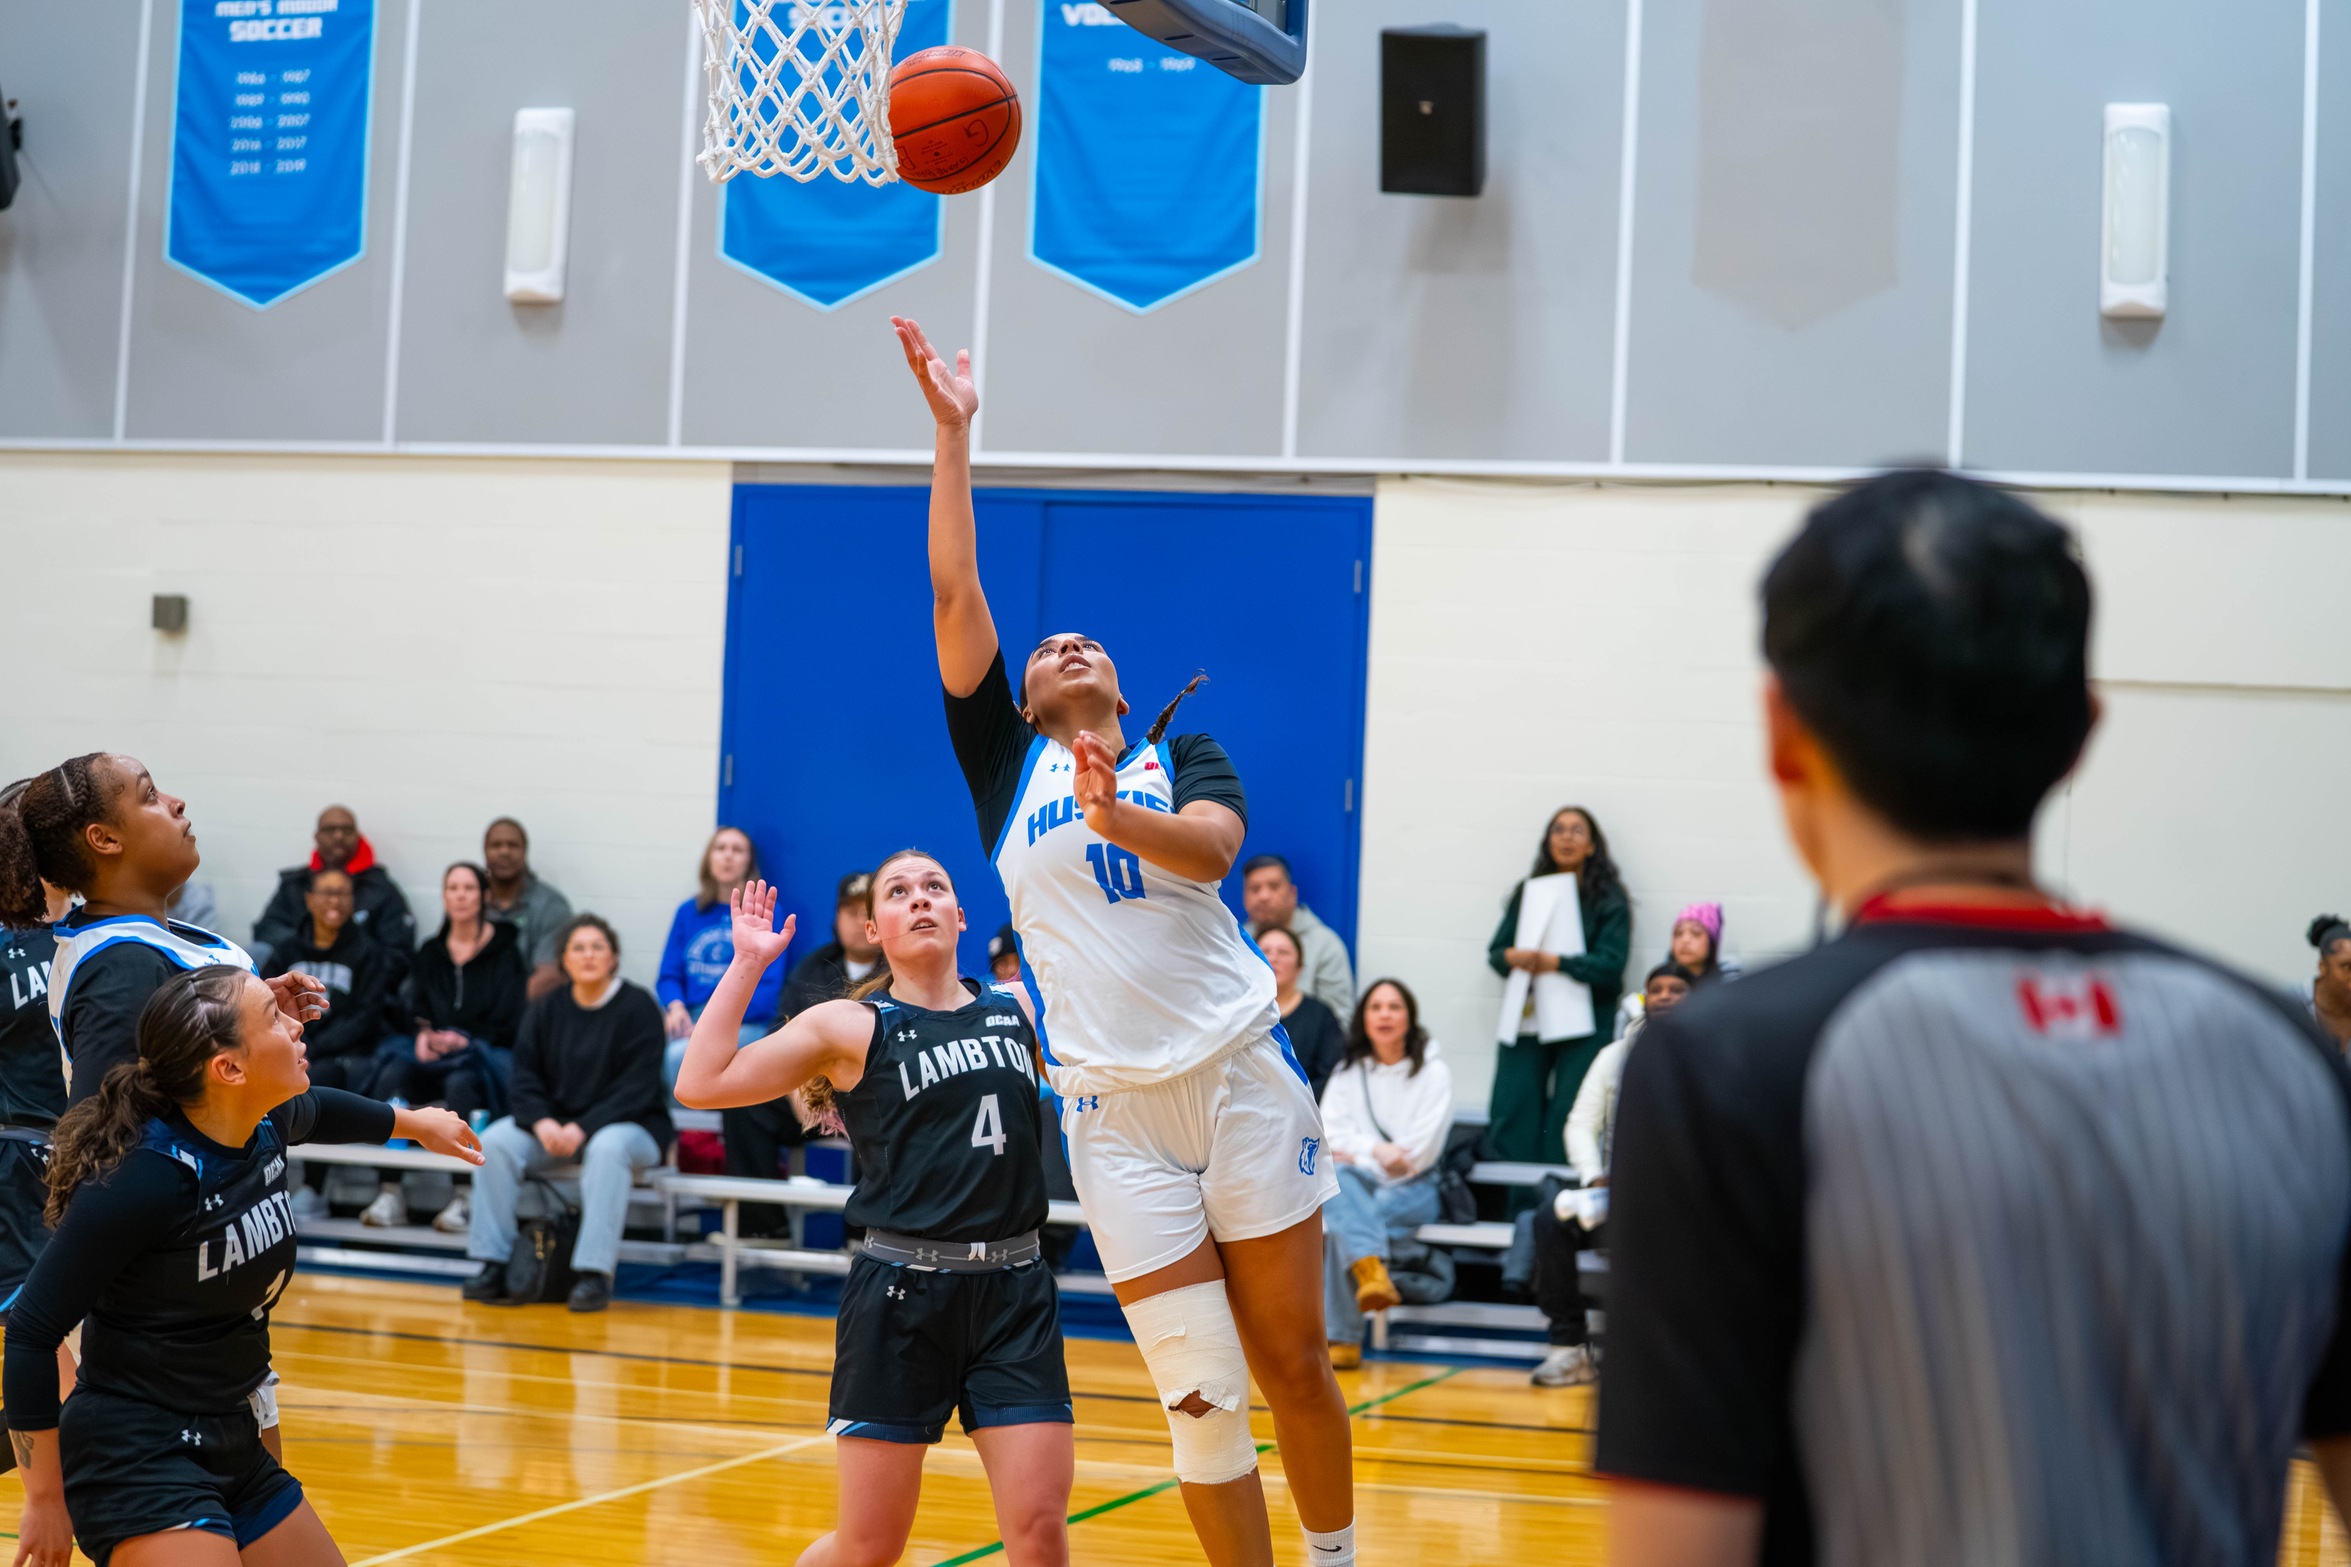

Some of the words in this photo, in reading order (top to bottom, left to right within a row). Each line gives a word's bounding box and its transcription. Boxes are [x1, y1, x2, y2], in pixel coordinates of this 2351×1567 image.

[229, 17, 323, 42] SOCCER
[1085, 842, 1147, 905] 10
[985, 1014, 1021, 1028] OCAA
[971, 1093, 1007, 1156] 4
